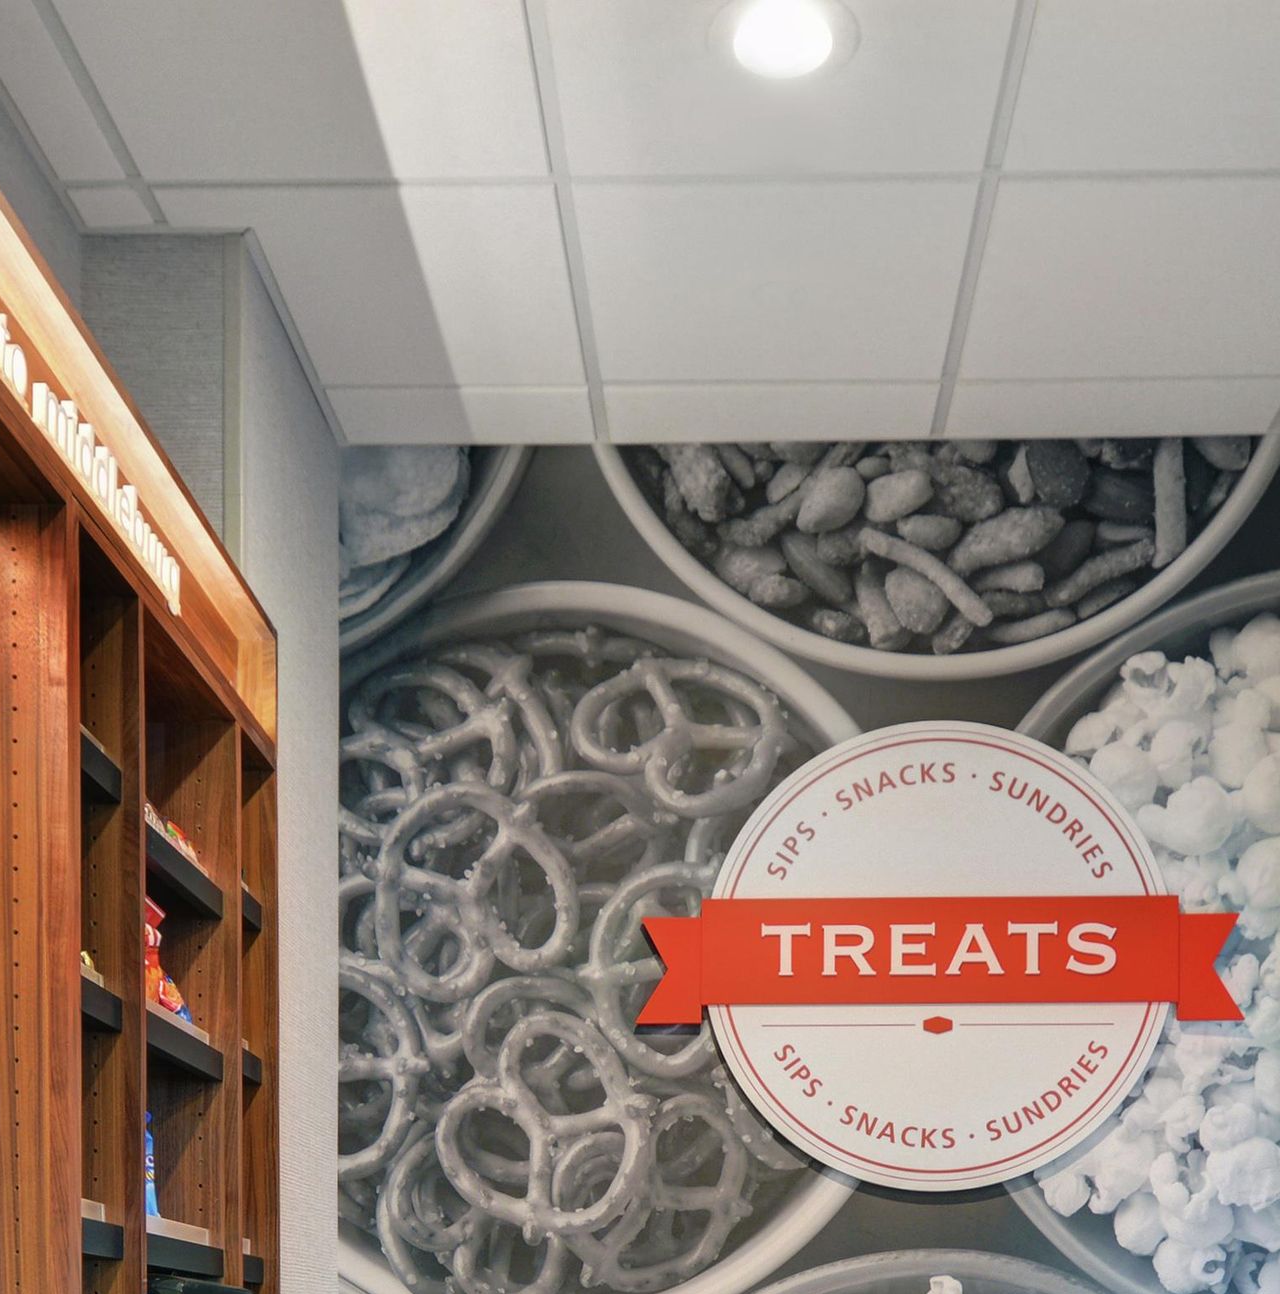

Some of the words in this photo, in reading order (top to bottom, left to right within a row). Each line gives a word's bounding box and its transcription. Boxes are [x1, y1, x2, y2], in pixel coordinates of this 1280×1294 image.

[766, 823, 816, 880] SIPS
[836, 762, 957, 811] SNACKS
[989, 771, 1114, 880] SUNDRIES
[761, 920, 1118, 977] TREATS
[774, 1044, 823, 1099] SIPS
[839, 1104, 956, 1149] SNACKS
[986, 1040, 1109, 1142] SUNDRIES
